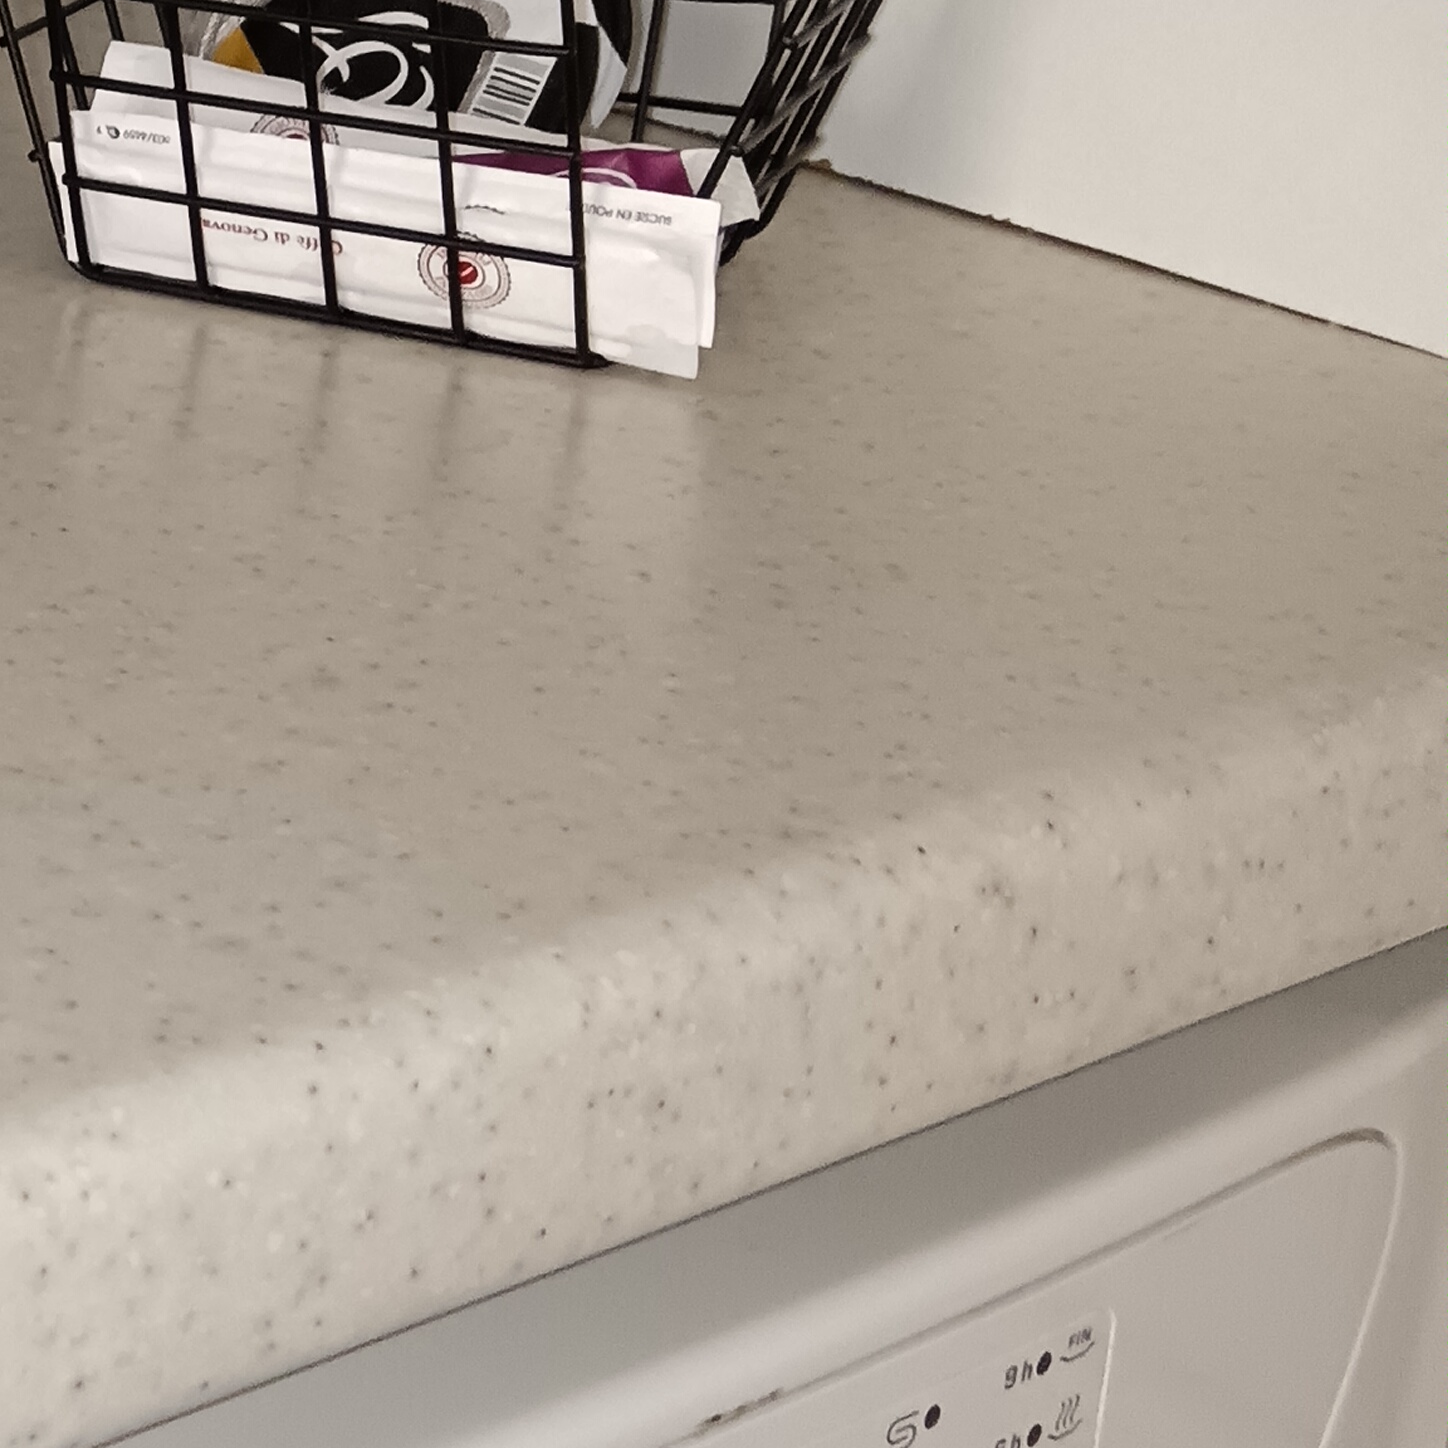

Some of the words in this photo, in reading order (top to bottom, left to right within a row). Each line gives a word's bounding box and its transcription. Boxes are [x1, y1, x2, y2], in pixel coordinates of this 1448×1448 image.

[202, 218, 268, 242] Genova
[274, 231, 290, 245] di
[296, 235, 343, 255] Cffè
[1068, 1327, 1093, 1349] FIN
